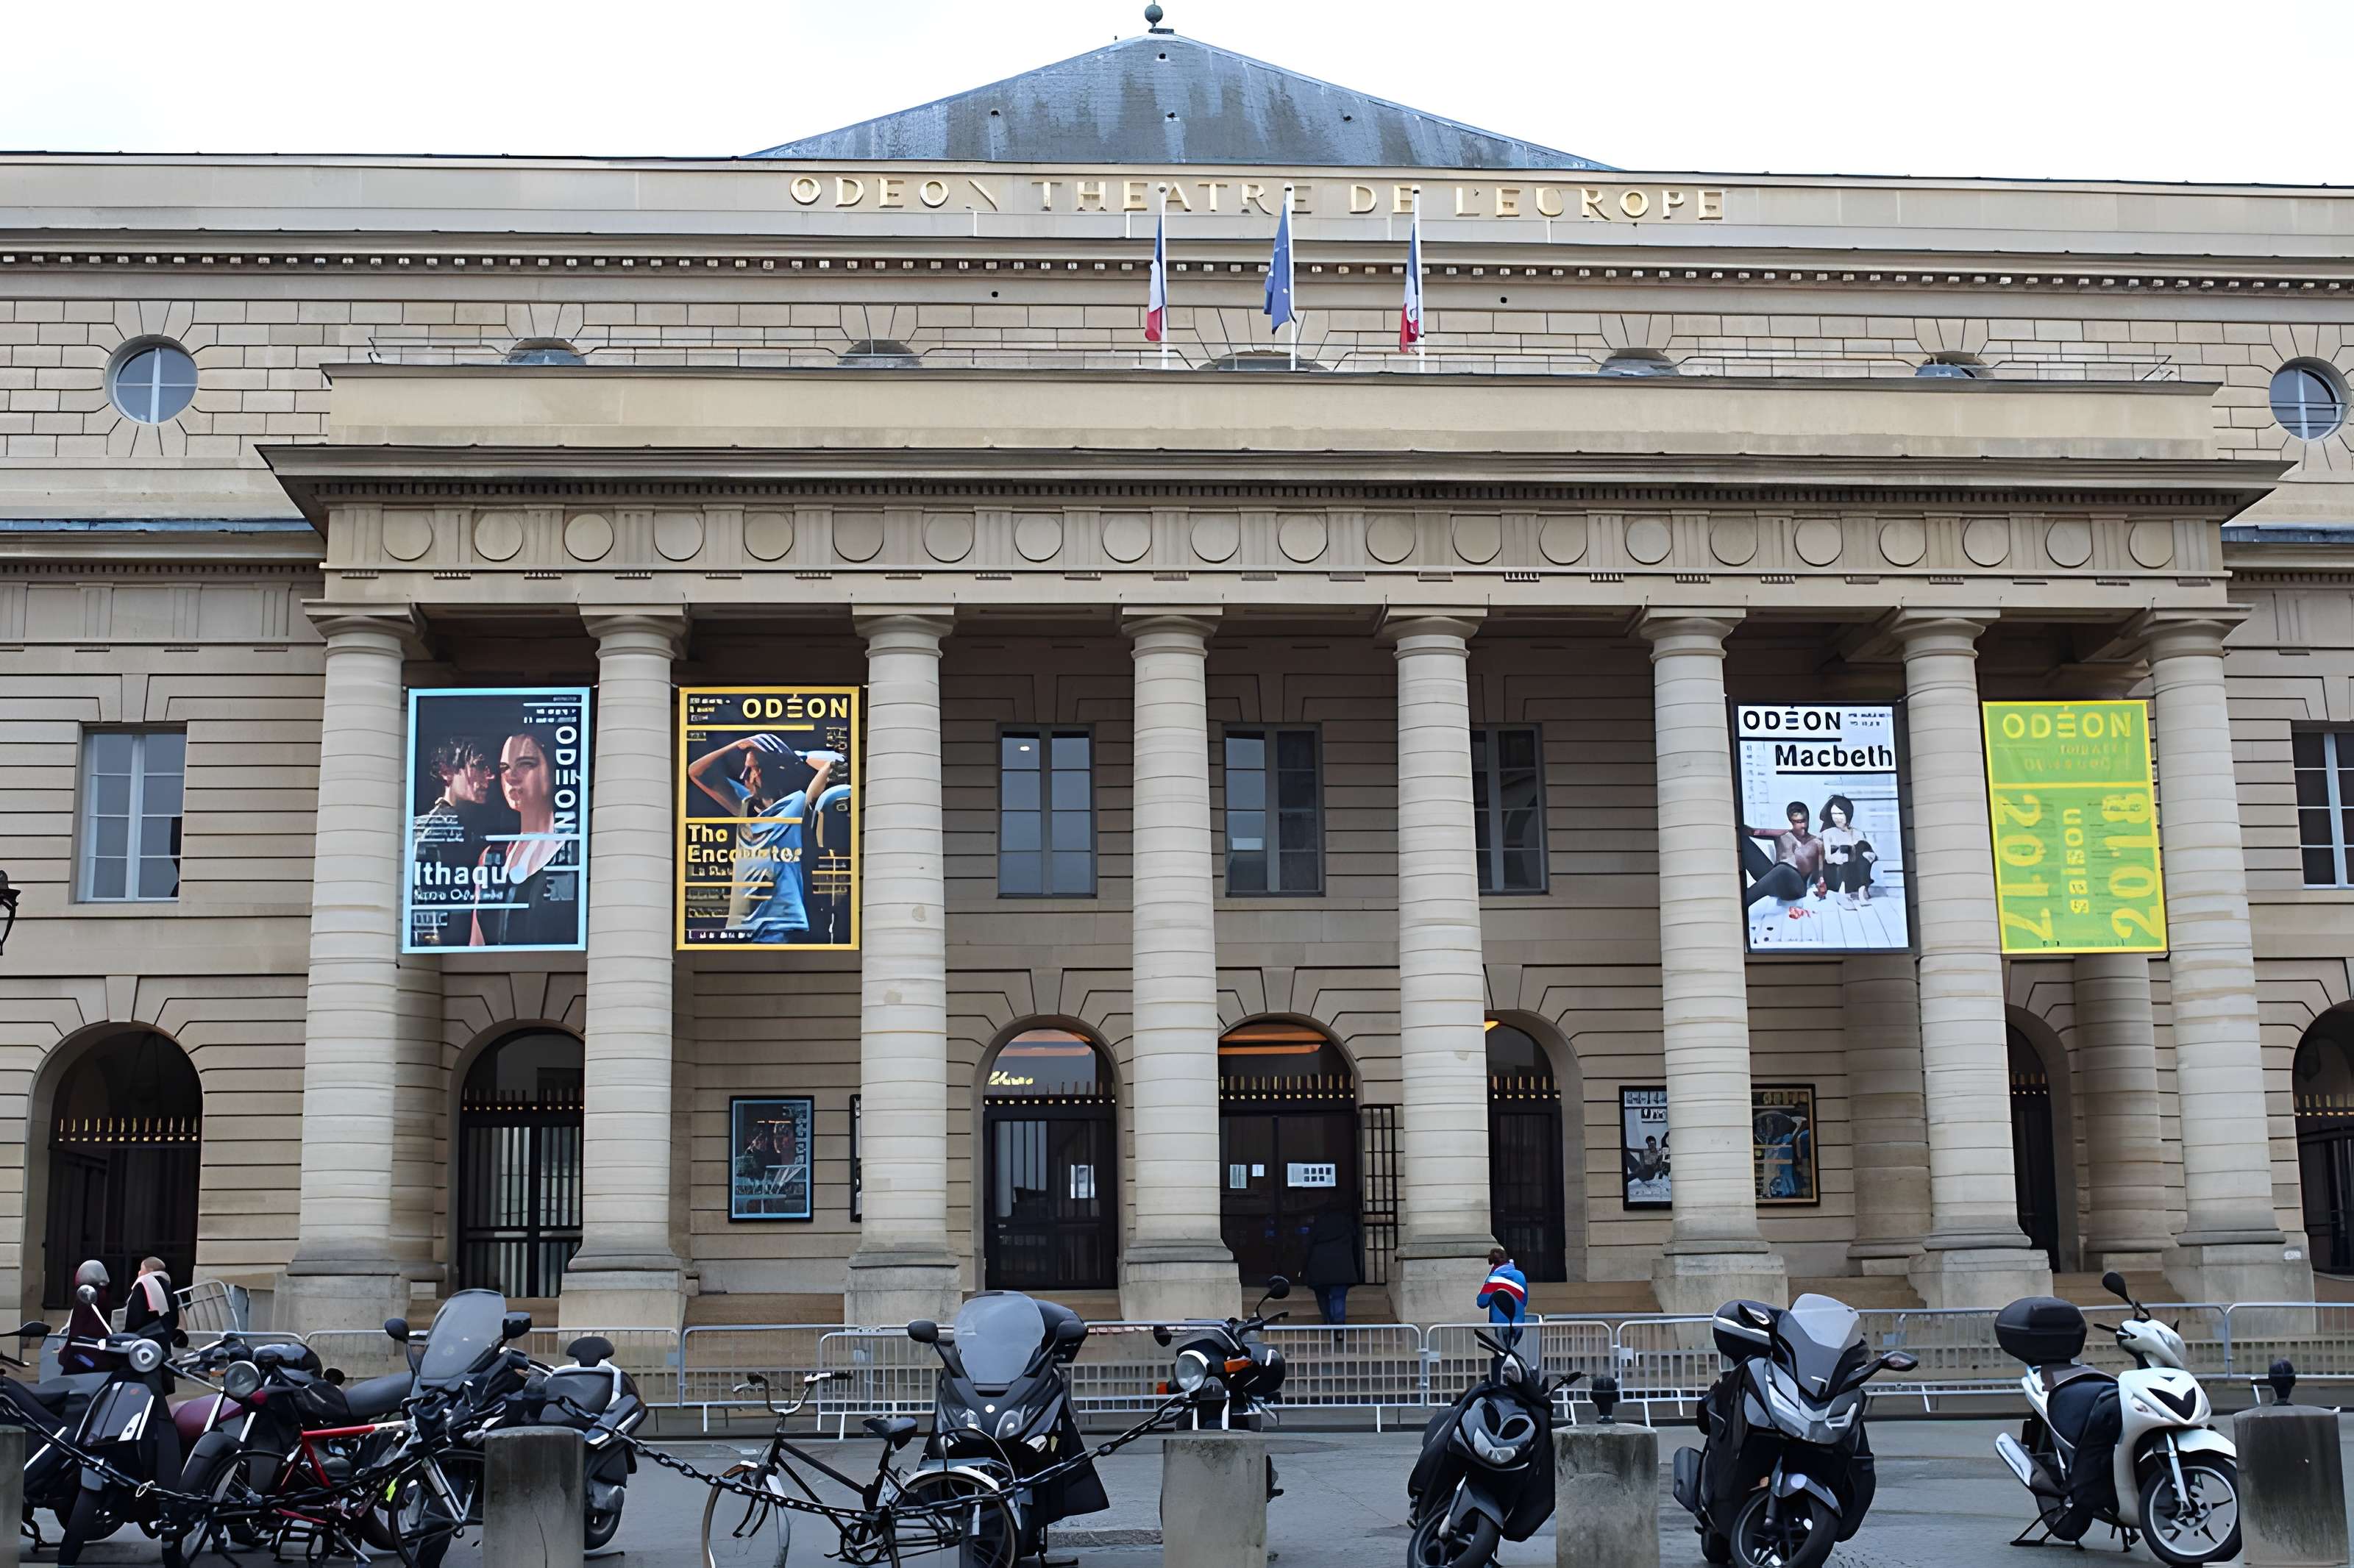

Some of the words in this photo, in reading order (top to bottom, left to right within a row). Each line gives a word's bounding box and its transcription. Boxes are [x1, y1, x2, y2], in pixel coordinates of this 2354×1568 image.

[1031, 181, 1312, 215] THEATRE
[1350, 184, 1418, 215] DE
[1455, 186, 1724, 221] L'EUROPE
[1774, 744, 1893, 767] Macbeth
[414, 860, 524, 889] Ithaqu
[1994, 794, 2053, 940] 2017
[2100, 792, 2161, 939] 2018
